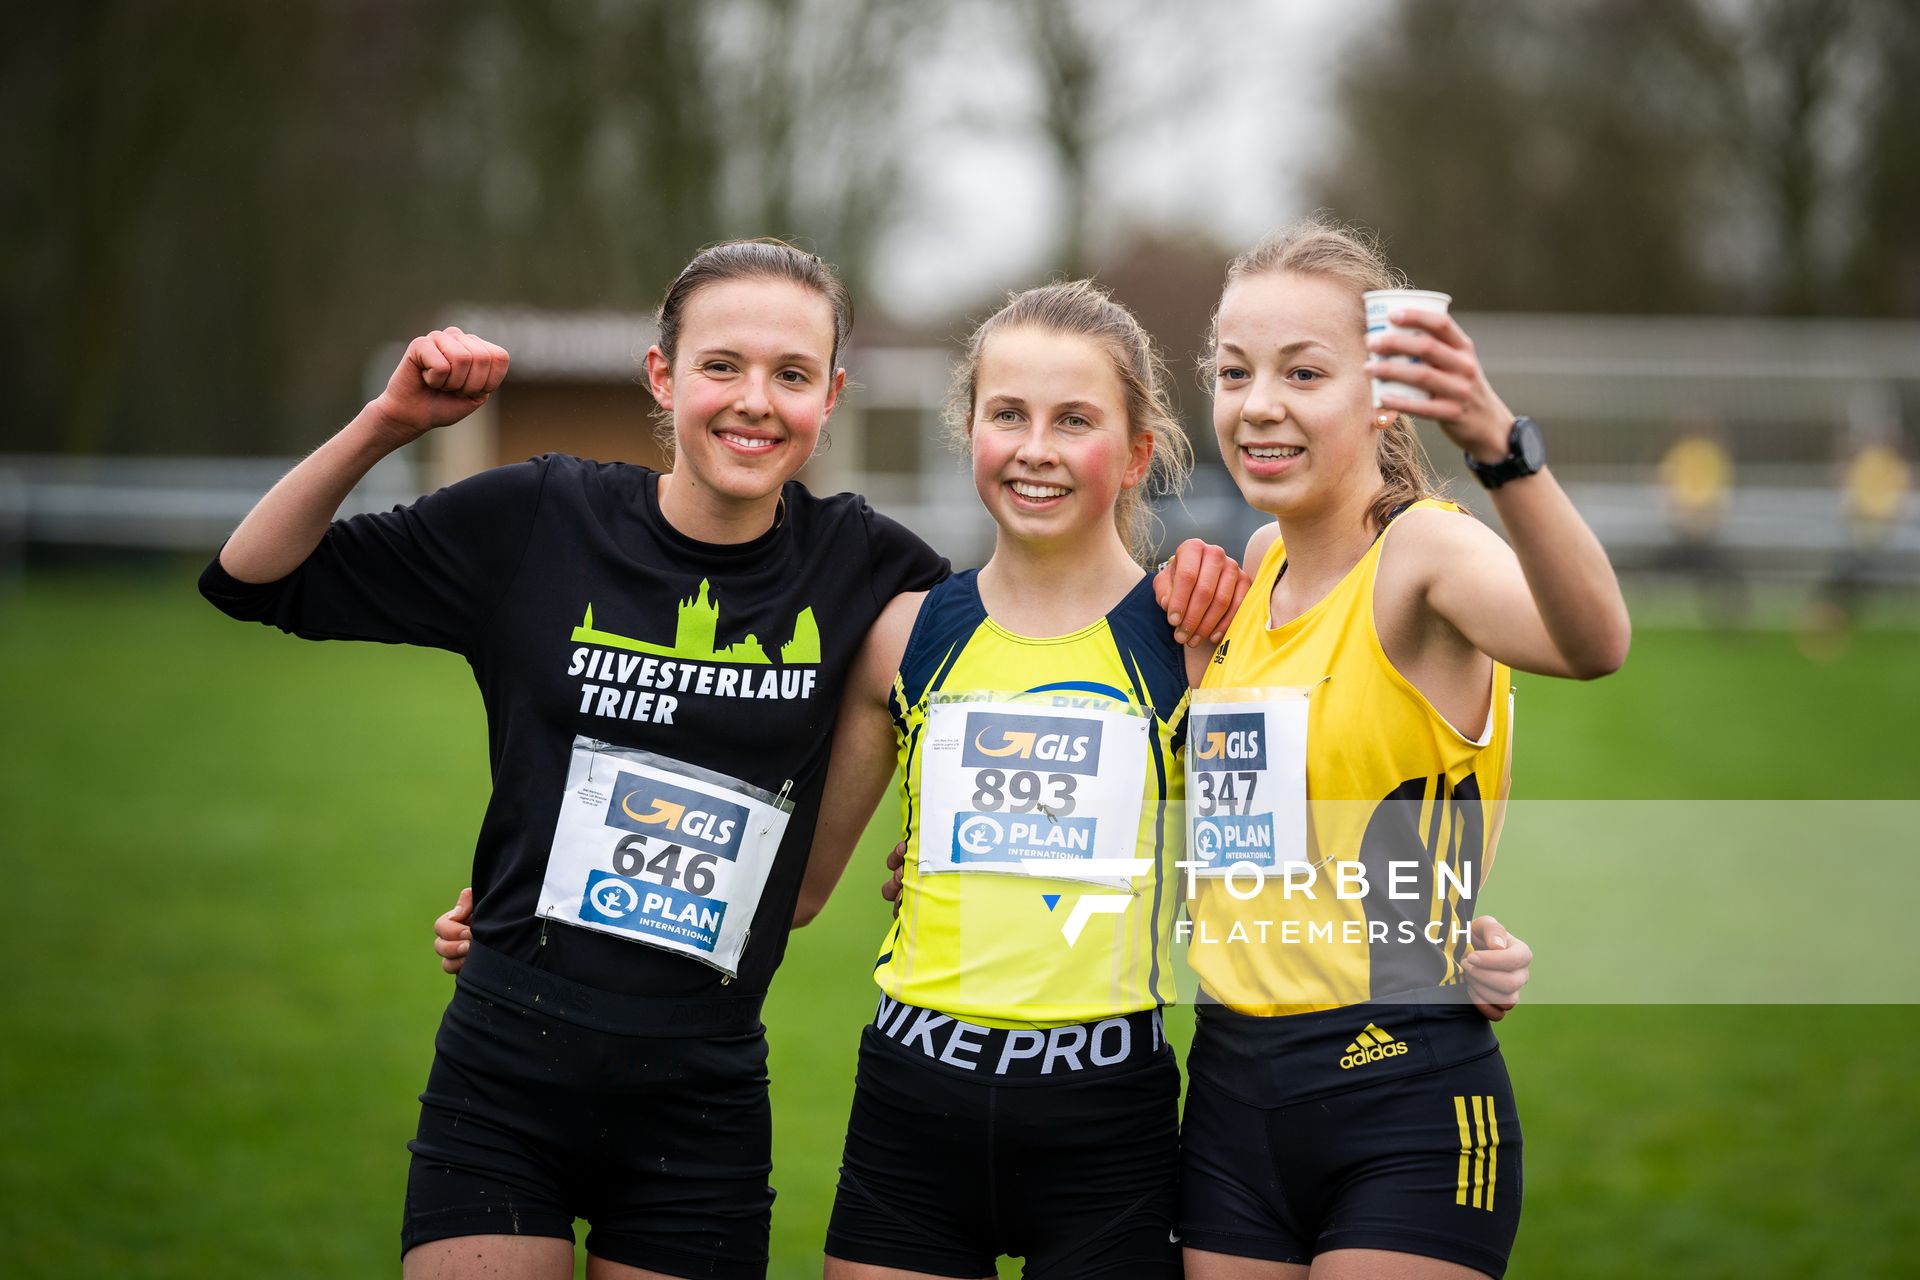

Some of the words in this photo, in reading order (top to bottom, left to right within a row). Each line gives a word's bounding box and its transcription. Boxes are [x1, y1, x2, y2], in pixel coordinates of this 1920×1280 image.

[567, 647, 817, 700] SILVESTERLAUF
[579, 684, 679, 725] TRIER
[1034, 733, 1090, 763] GLS
[1225, 729, 1259, 760] GLS
[971, 768, 1078, 818] 893
[1197, 771, 1258, 817] 347
[680, 810, 736, 846] GLS
[1008, 822, 1090, 851] PLAN
[1223, 824, 1271, 848] PLAN
[611, 833, 719, 897] 646
[1225, 851, 1272, 860] INTERNATIONAL
[641, 892, 721, 933] PLAN
[639, 917, 713, 945] INTERNATIONAL
[875, 989, 991, 1071] NIKE
[994, 1016, 1132, 1075] PRO
[1339, 1041, 1409, 1070] adidas
